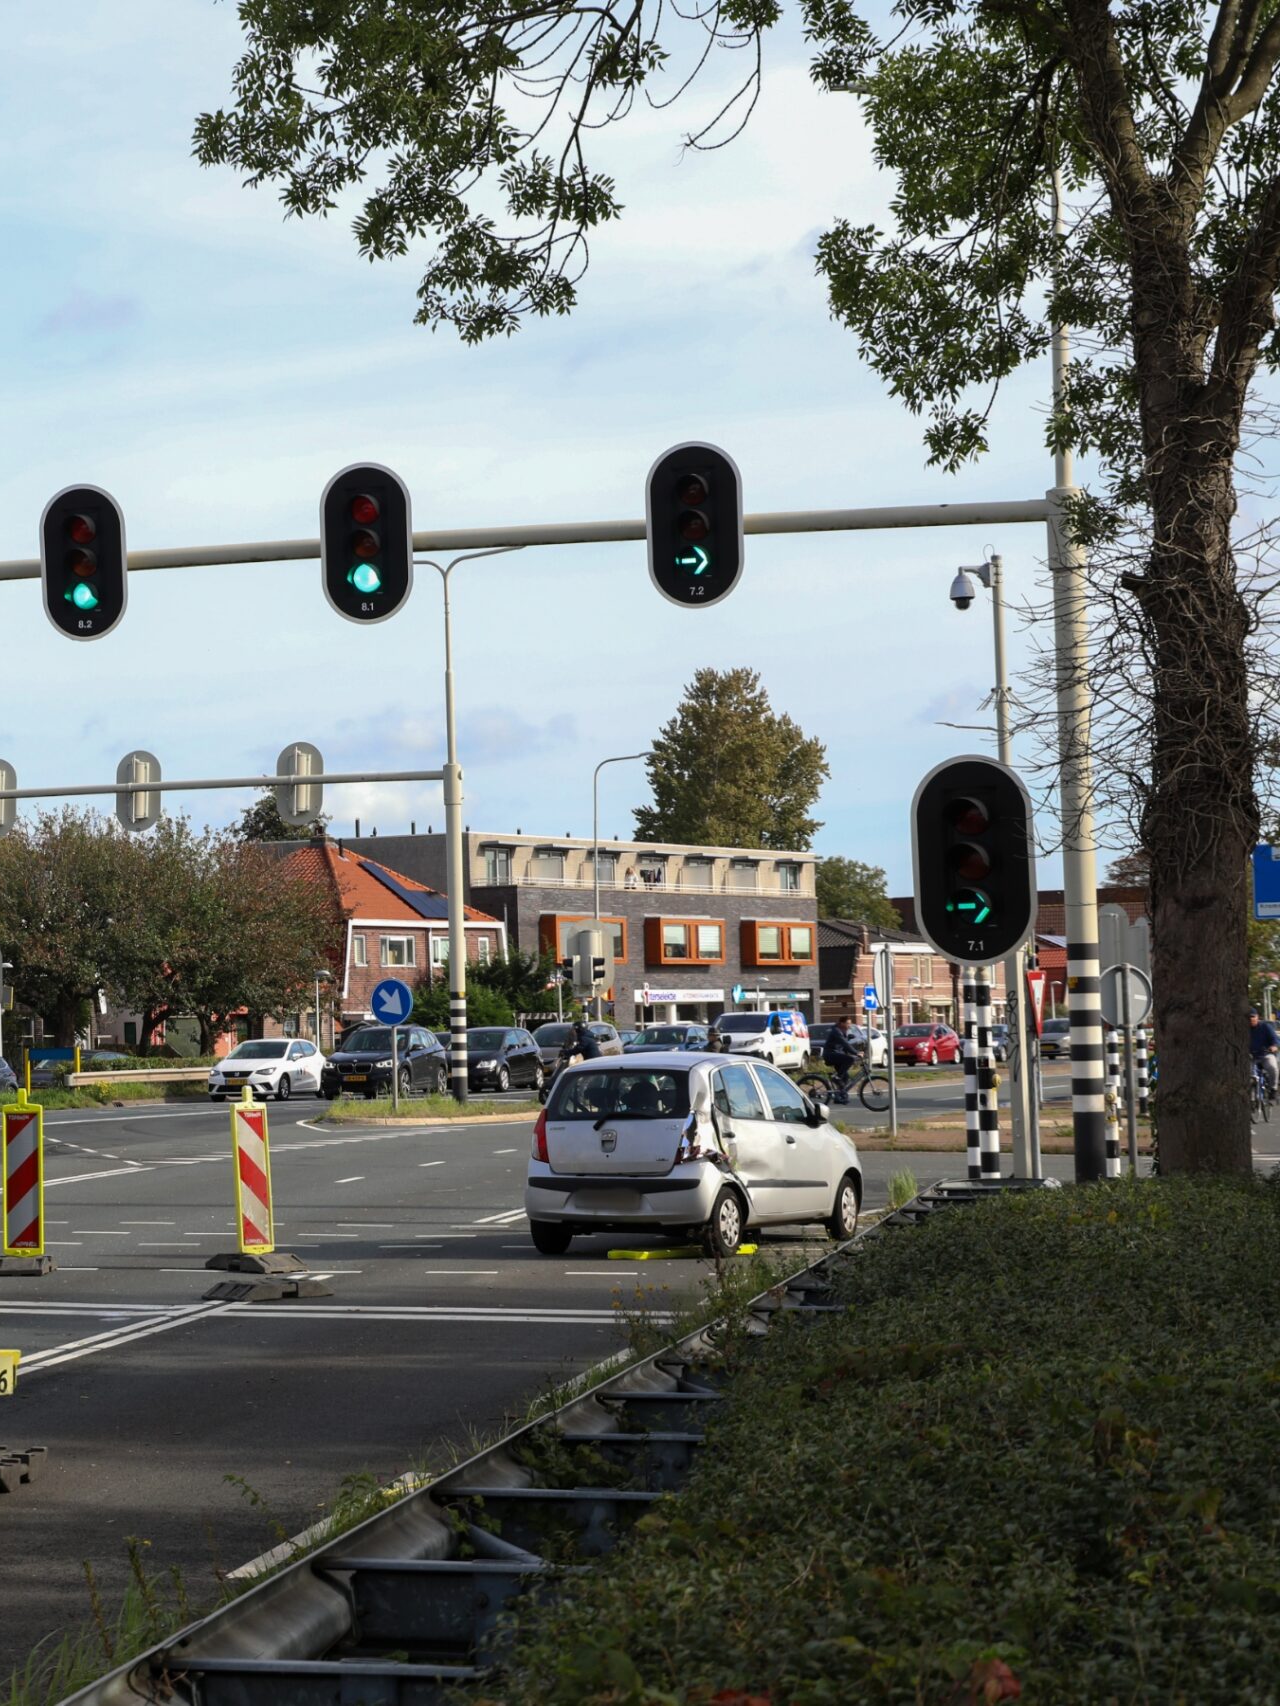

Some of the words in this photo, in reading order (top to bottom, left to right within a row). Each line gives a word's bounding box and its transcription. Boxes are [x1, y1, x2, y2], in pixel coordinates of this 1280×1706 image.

[689, 586, 705, 596] 7.2
[361, 602, 374, 611] 8.1
[78, 620, 92, 629] 8.2
[967, 940, 984, 951] 7.1
